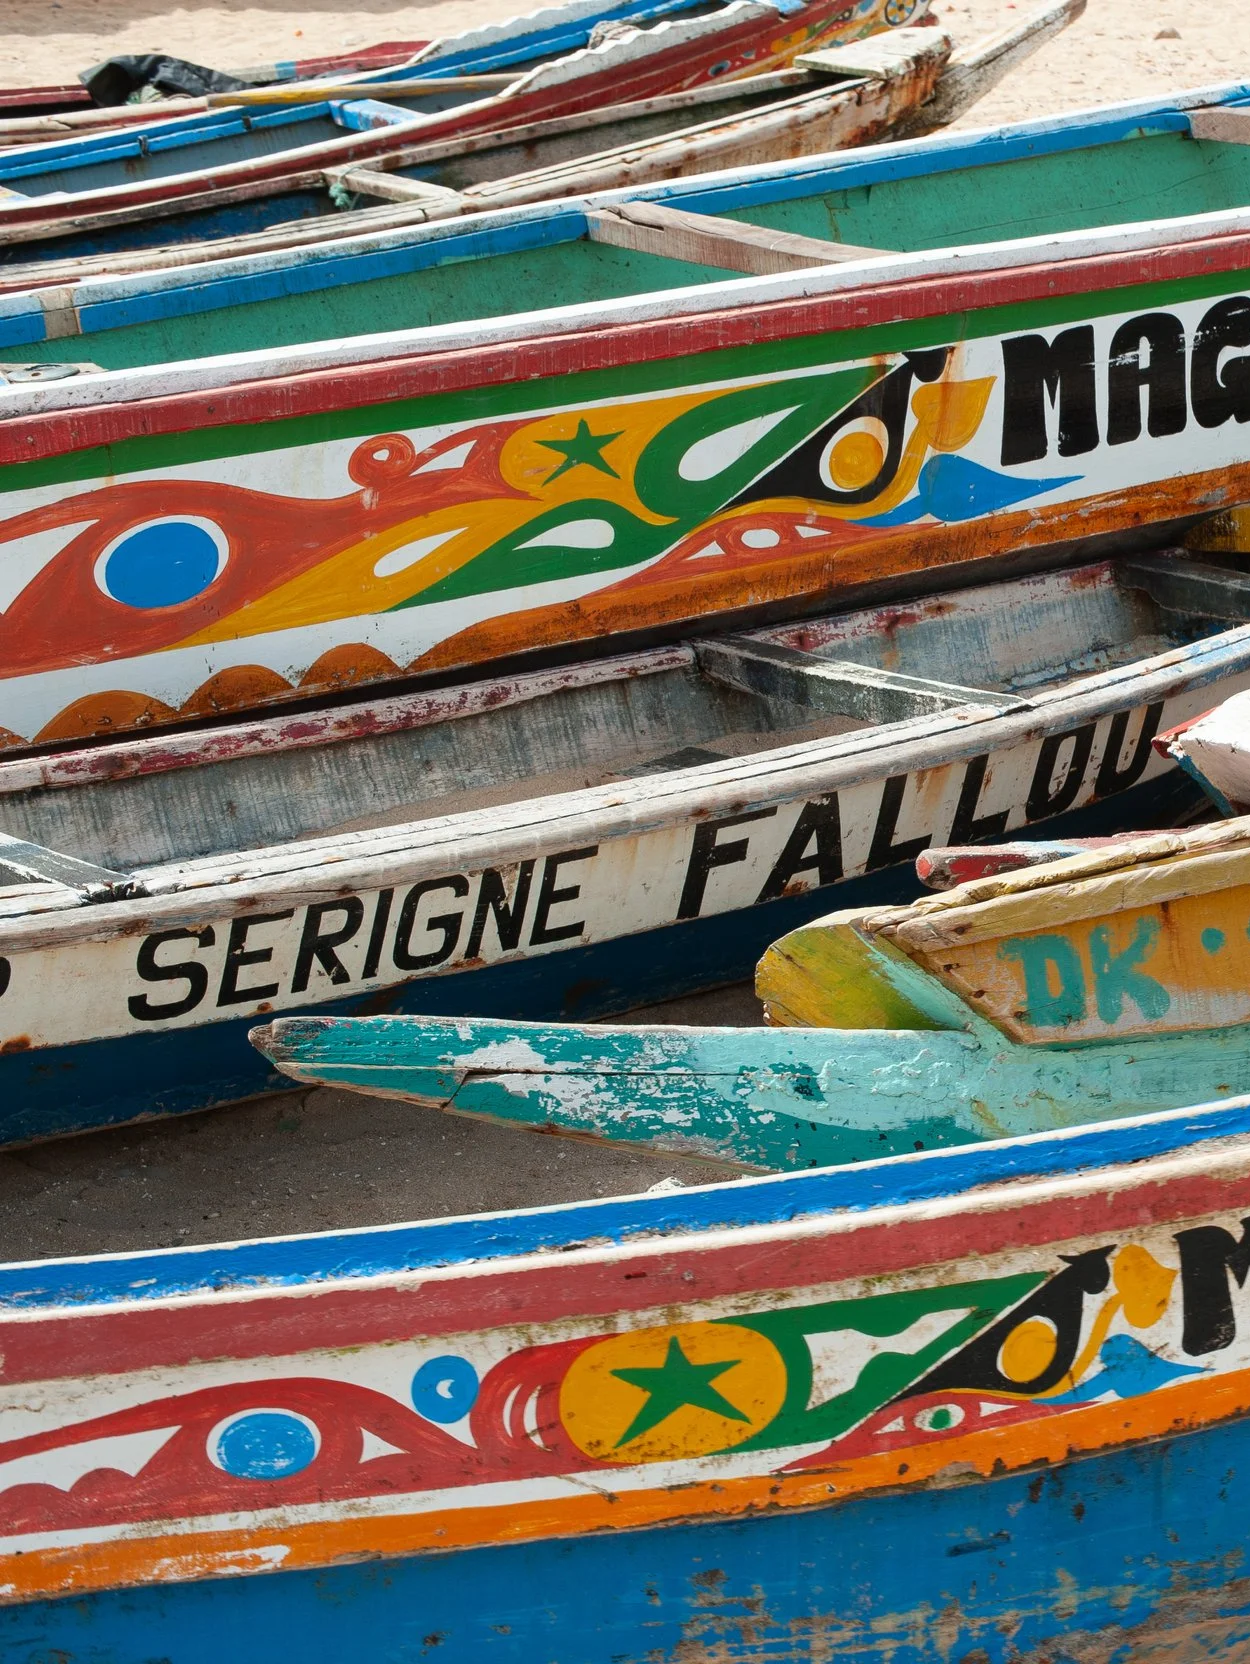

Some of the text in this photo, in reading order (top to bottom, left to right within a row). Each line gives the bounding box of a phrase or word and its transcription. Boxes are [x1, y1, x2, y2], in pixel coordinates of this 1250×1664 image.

[127, 700, 1165, 1021] SERIGNE FALLOU
[996, 915, 1171, 1026] DK
